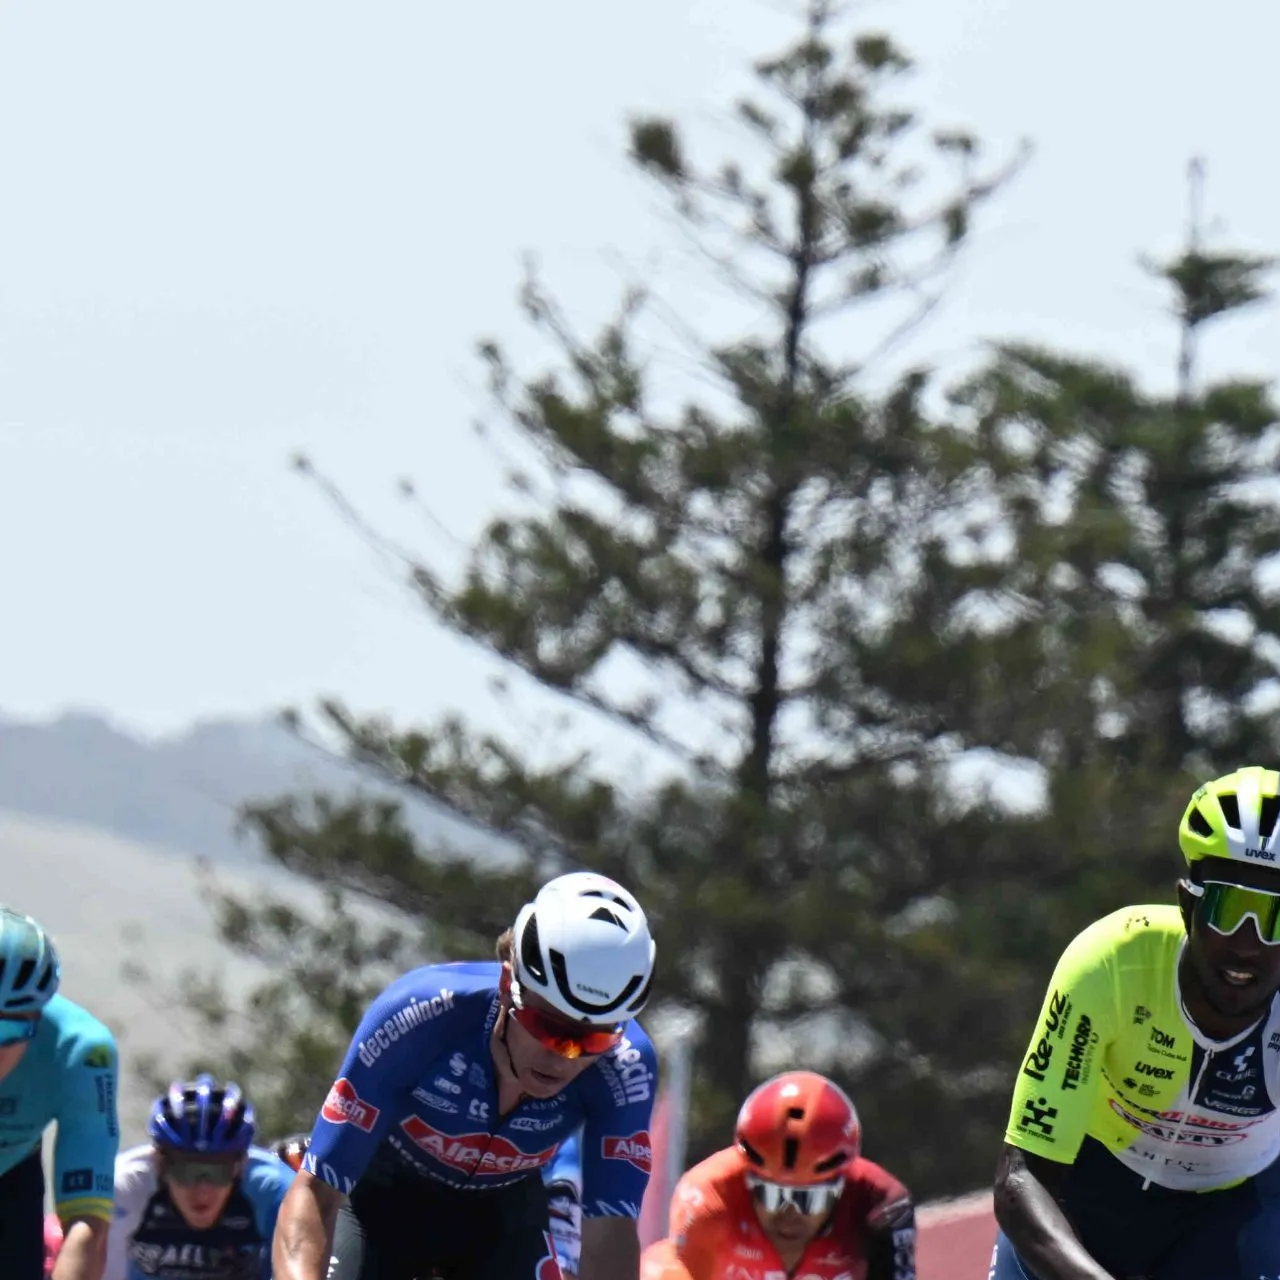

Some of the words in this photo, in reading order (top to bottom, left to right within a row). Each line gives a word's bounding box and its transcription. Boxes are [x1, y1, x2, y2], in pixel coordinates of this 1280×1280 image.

[1245, 848, 1277, 862] uvex
[358, 988, 455, 1068] deceuninck
[1134, 1061, 1176, 1081] uvex
[420, 1134, 541, 1170] Alpecin
[615, 1141, 651, 1159] Alpe
